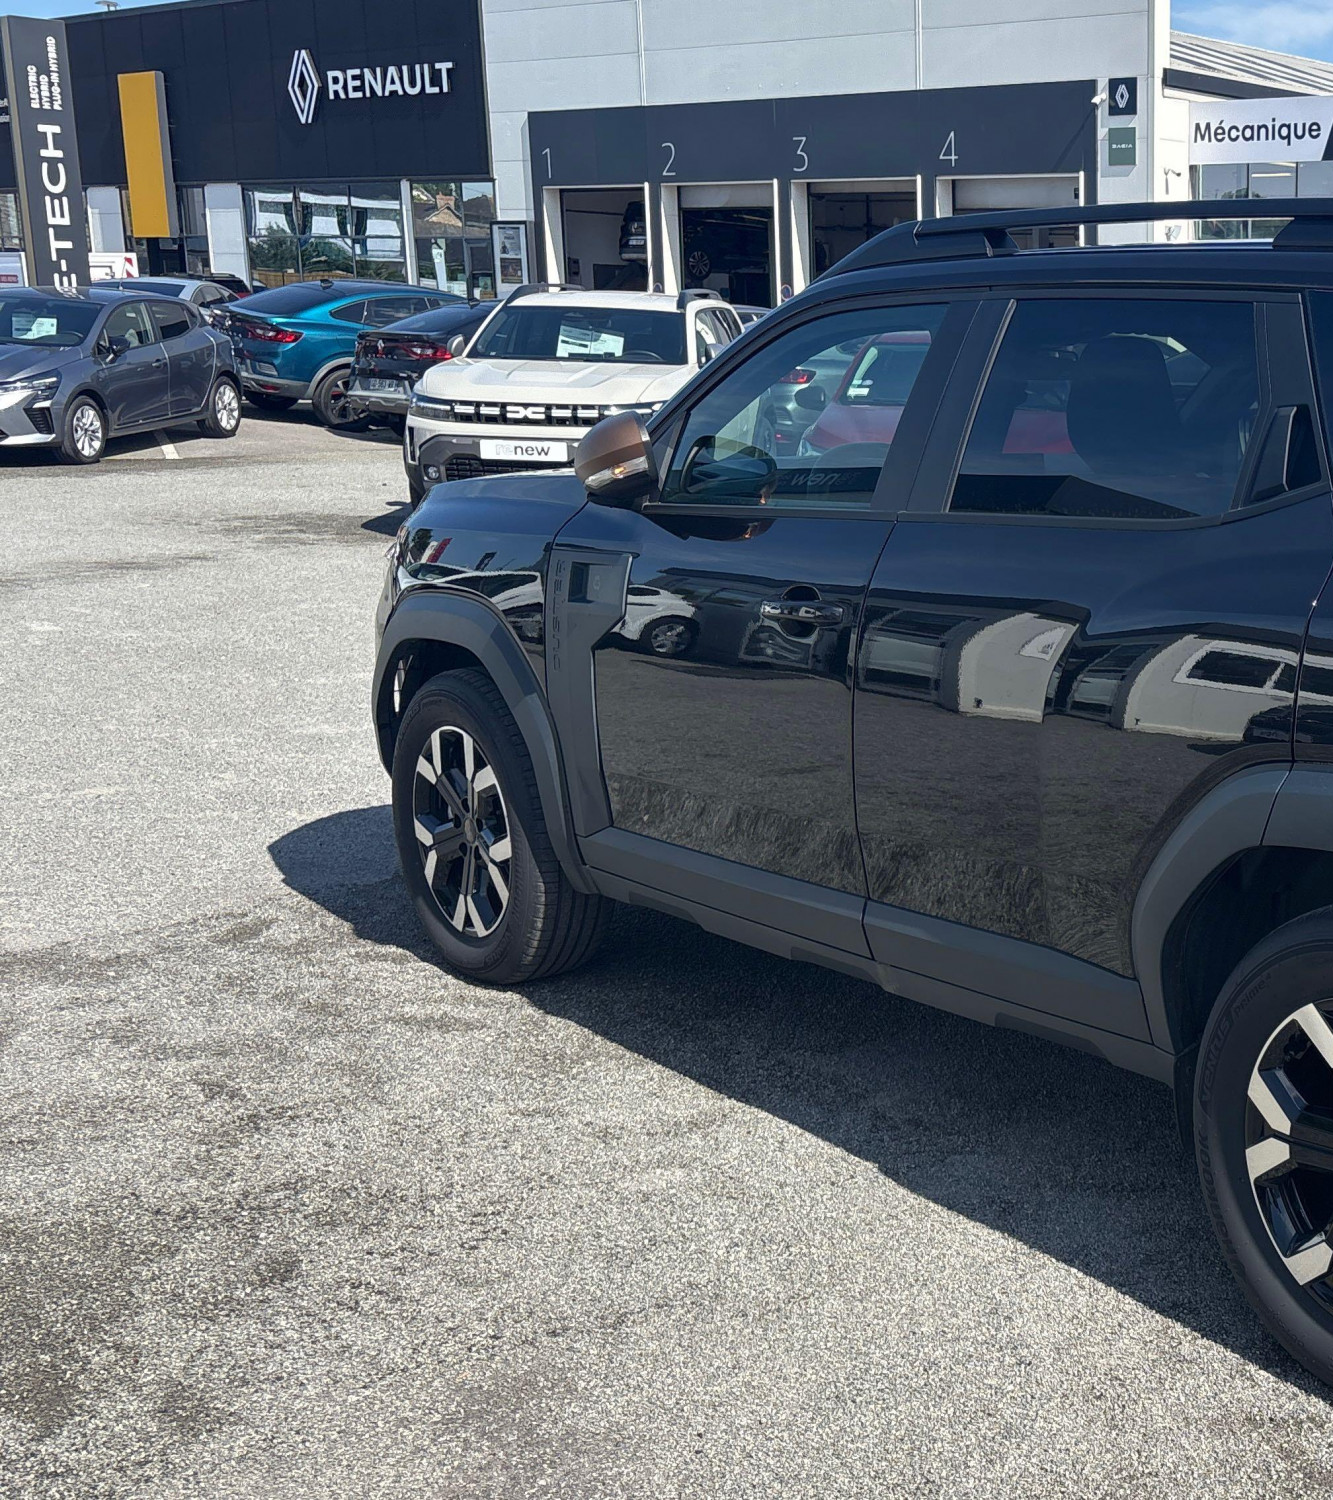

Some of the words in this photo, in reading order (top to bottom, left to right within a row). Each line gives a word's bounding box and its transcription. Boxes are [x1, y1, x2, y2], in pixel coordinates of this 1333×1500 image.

[45, 36, 59, 71] HYBRID
[26, 64, 41, 109] ELECTRIC
[39, 74, 52, 110] HYBRID
[50, 72, 64, 111] PLUG-IN
[326, 61, 453, 100] RENAULT
[938, 130, 959, 168] 4
[1193, 117, 1322, 146] Mécanique
[541, 147, 552, 179] 1
[661, 142, 677, 176] 2
[792, 136, 809, 172] 3
